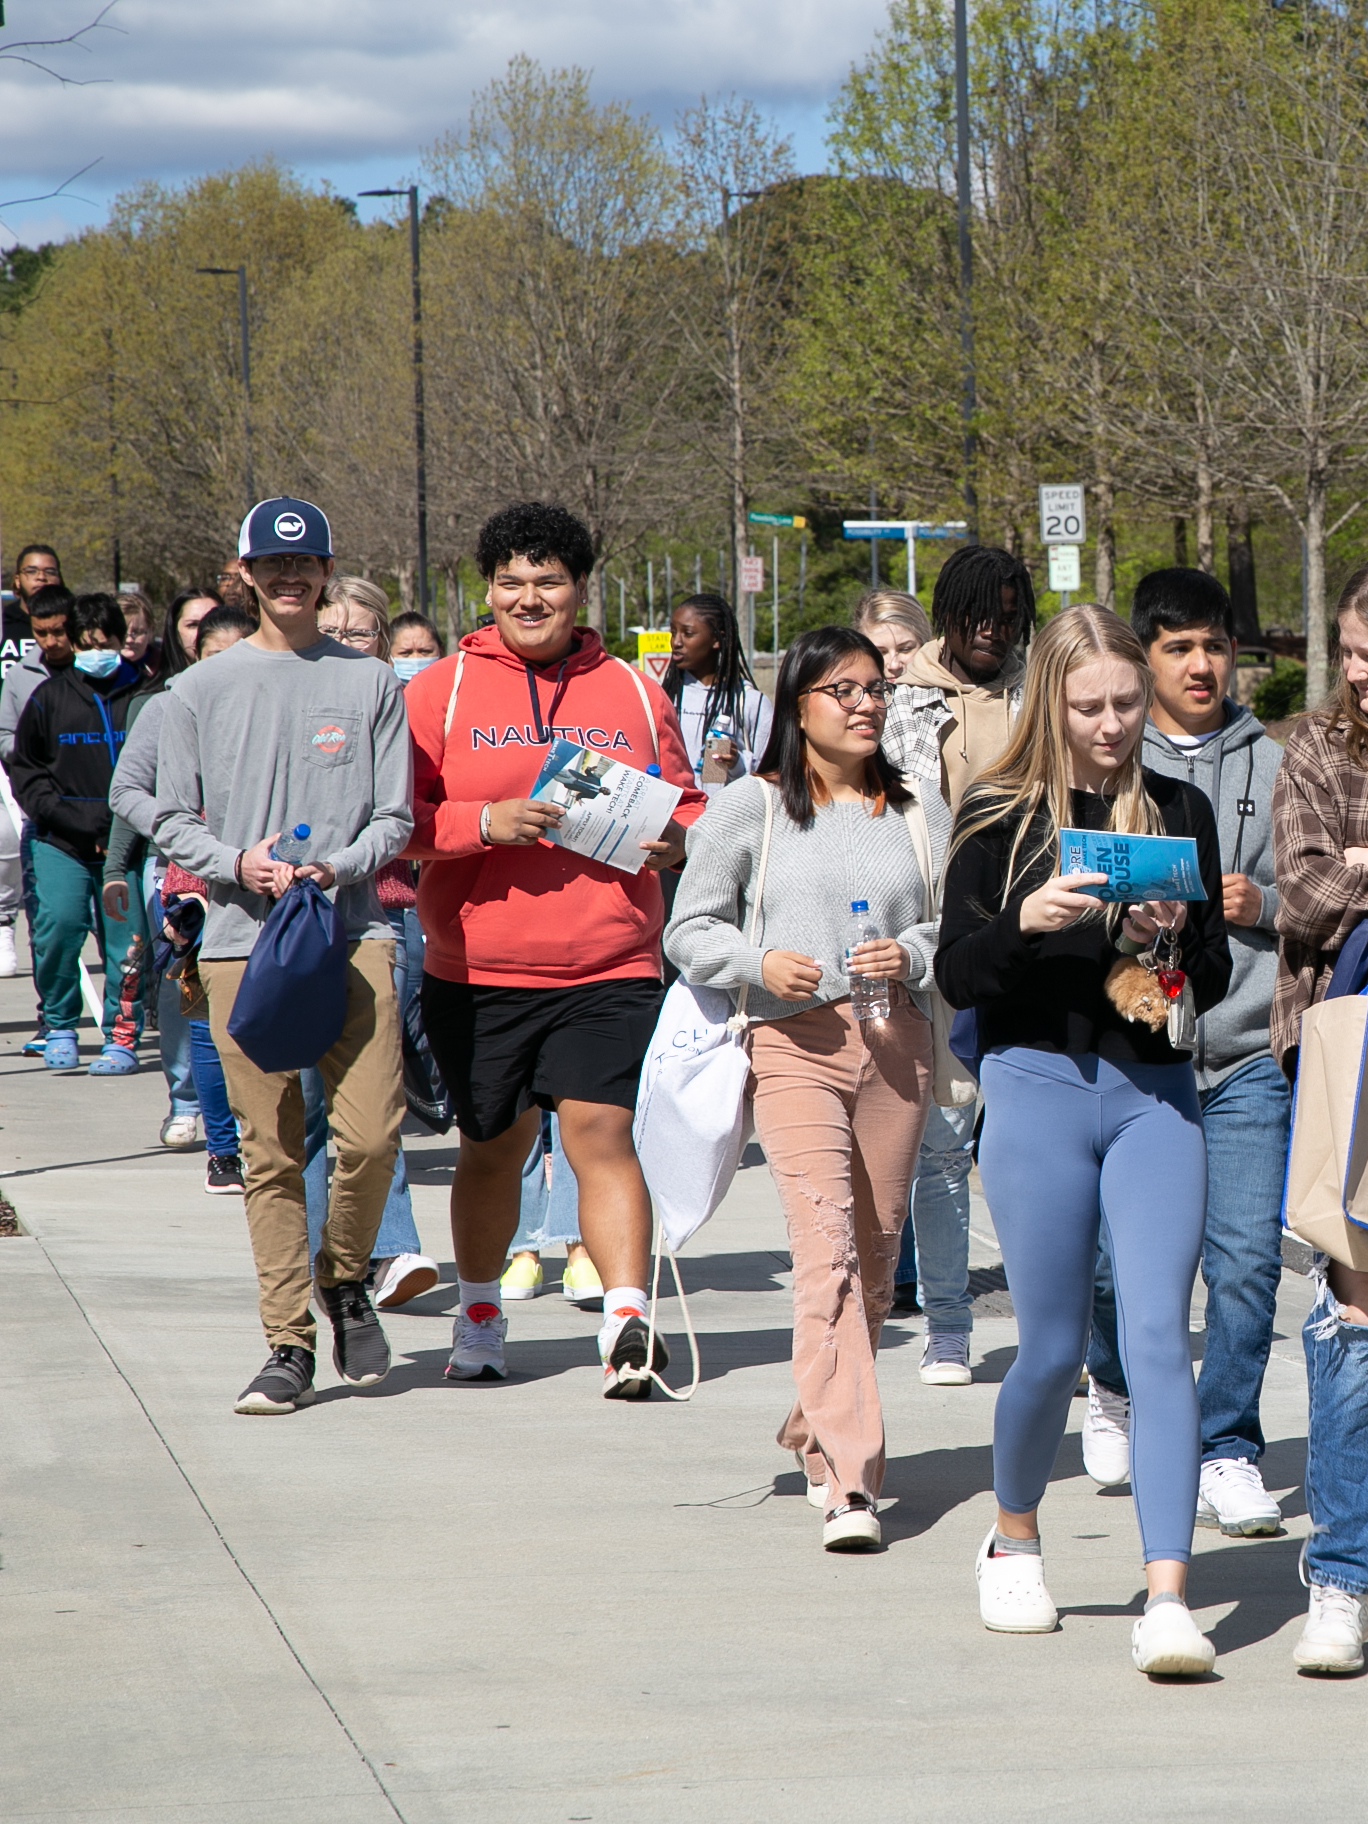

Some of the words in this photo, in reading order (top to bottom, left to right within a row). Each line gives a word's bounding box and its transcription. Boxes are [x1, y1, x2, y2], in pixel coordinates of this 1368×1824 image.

[1044, 490, 1079, 500] SPEED
[1048, 503, 1076, 512] LIMIT
[1046, 515, 1080, 536] 20
[647, 634, 669, 642] STATE
[471, 724, 634, 752] NAUTICA
[616, 769, 631, 792] WAKE
[620, 772, 637, 799] STARTS
[606, 793, 620, 815] TECH!
[616, 798, 625, 810] AT
[621, 775, 646, 819] COMEBACK
[633, 785, 649, 810] GREAT
[581, 812, 592, 827] APPLY
[1114, 843, 1134, 900] HOUSE
